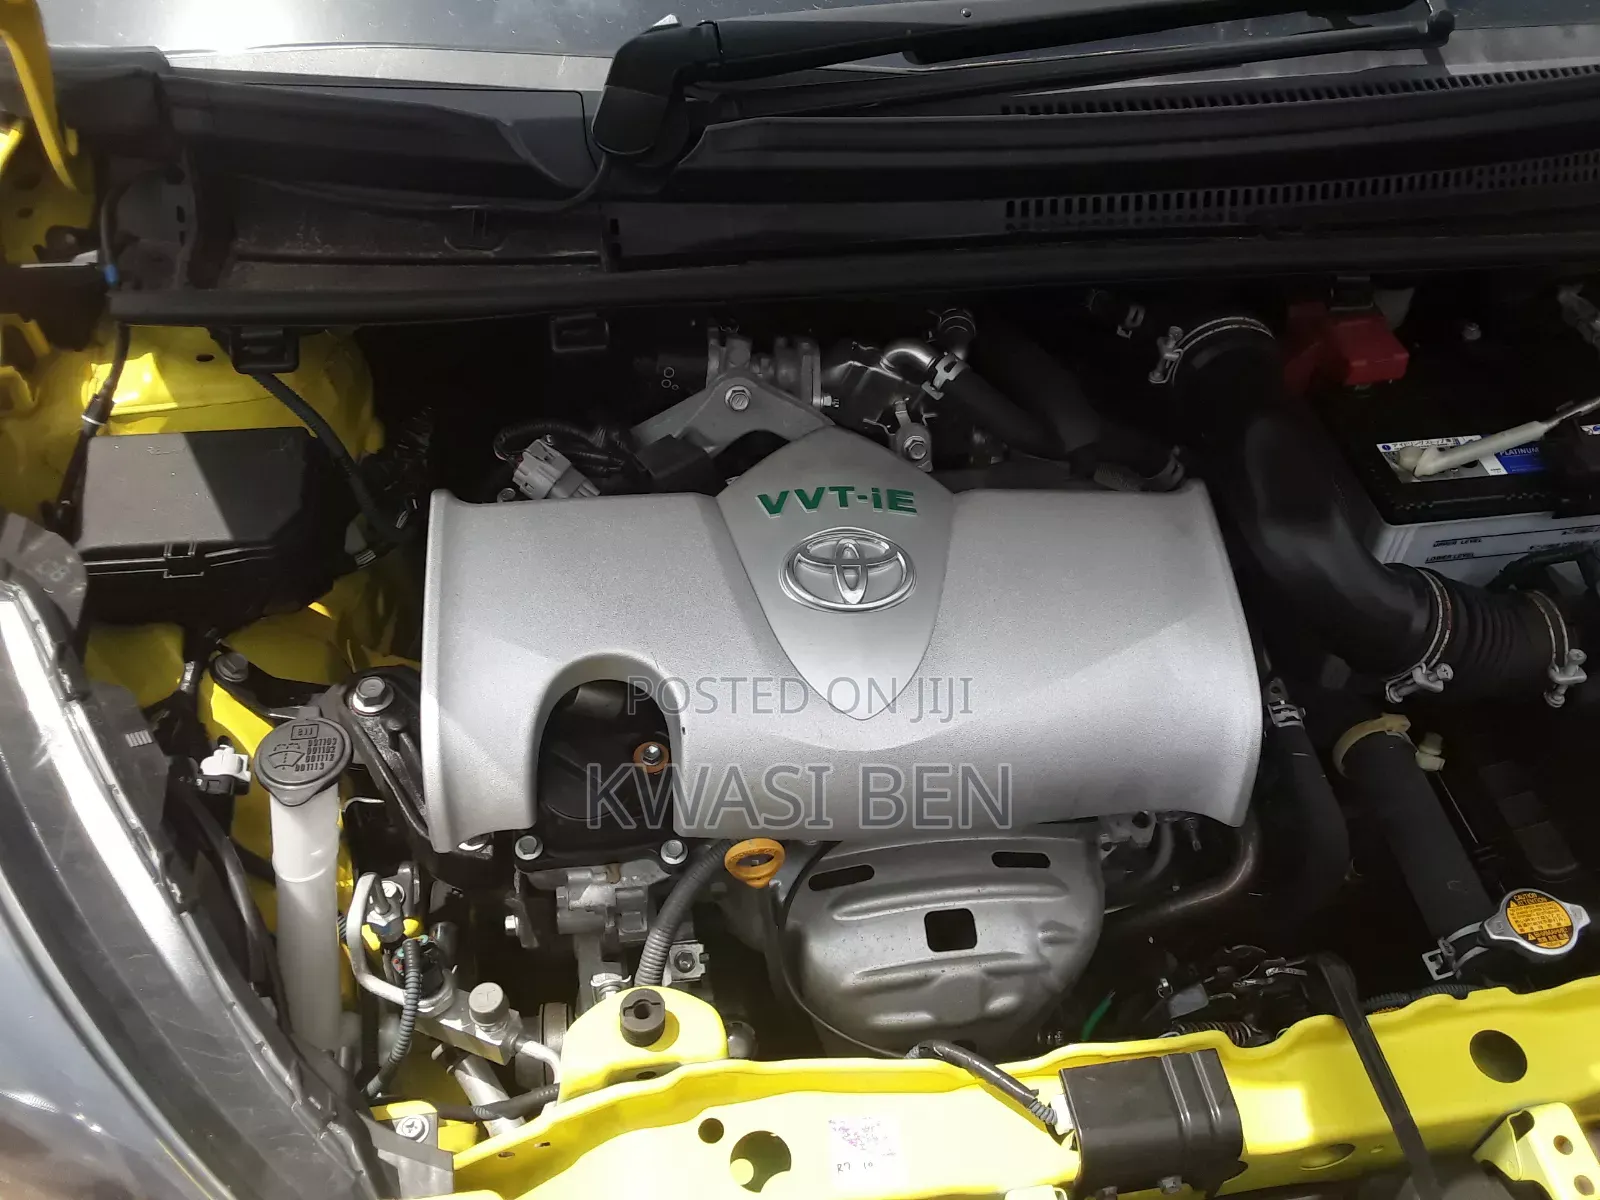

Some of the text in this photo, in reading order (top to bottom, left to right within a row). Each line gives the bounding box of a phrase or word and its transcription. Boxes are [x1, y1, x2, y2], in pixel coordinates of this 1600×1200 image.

[1499, 447, 1540, 456] PLATINUM
[755, 485, 918, 518] VVT-iE
[1513, 893, 1537, 901] CAUTION
